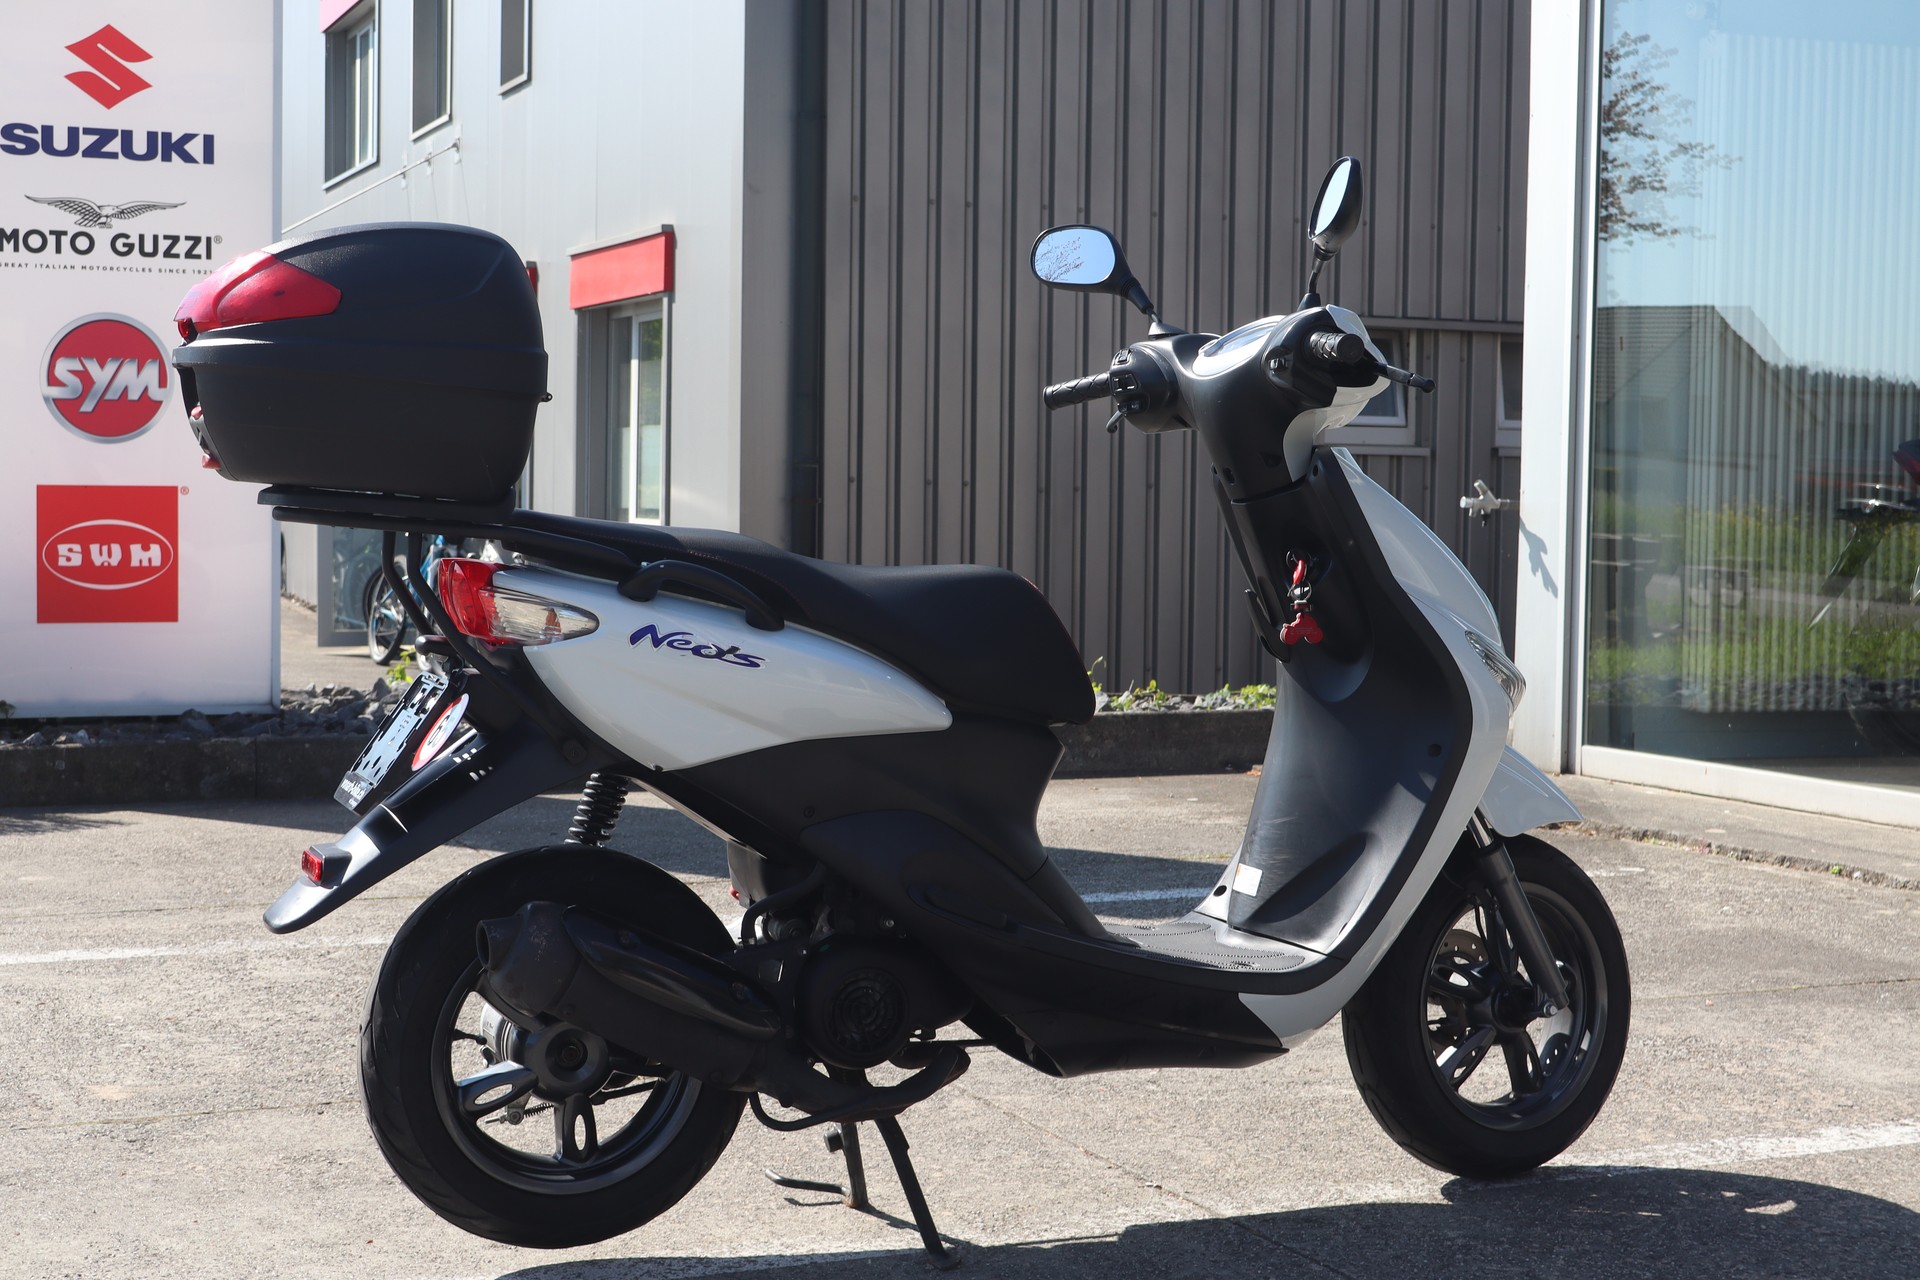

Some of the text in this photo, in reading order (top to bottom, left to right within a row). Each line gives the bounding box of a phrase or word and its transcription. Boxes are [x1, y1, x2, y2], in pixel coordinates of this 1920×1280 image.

[0, 122, 215, 165] SUZUKI
[0, 227, 96, 256] MOTO
[34, 262, 76, 271] ITALIAN
[81, 264, 153, 274] MOTORCYCLES
[158, 267, 187, 275] SINCE
[47, 356, 167, 413] SYM
